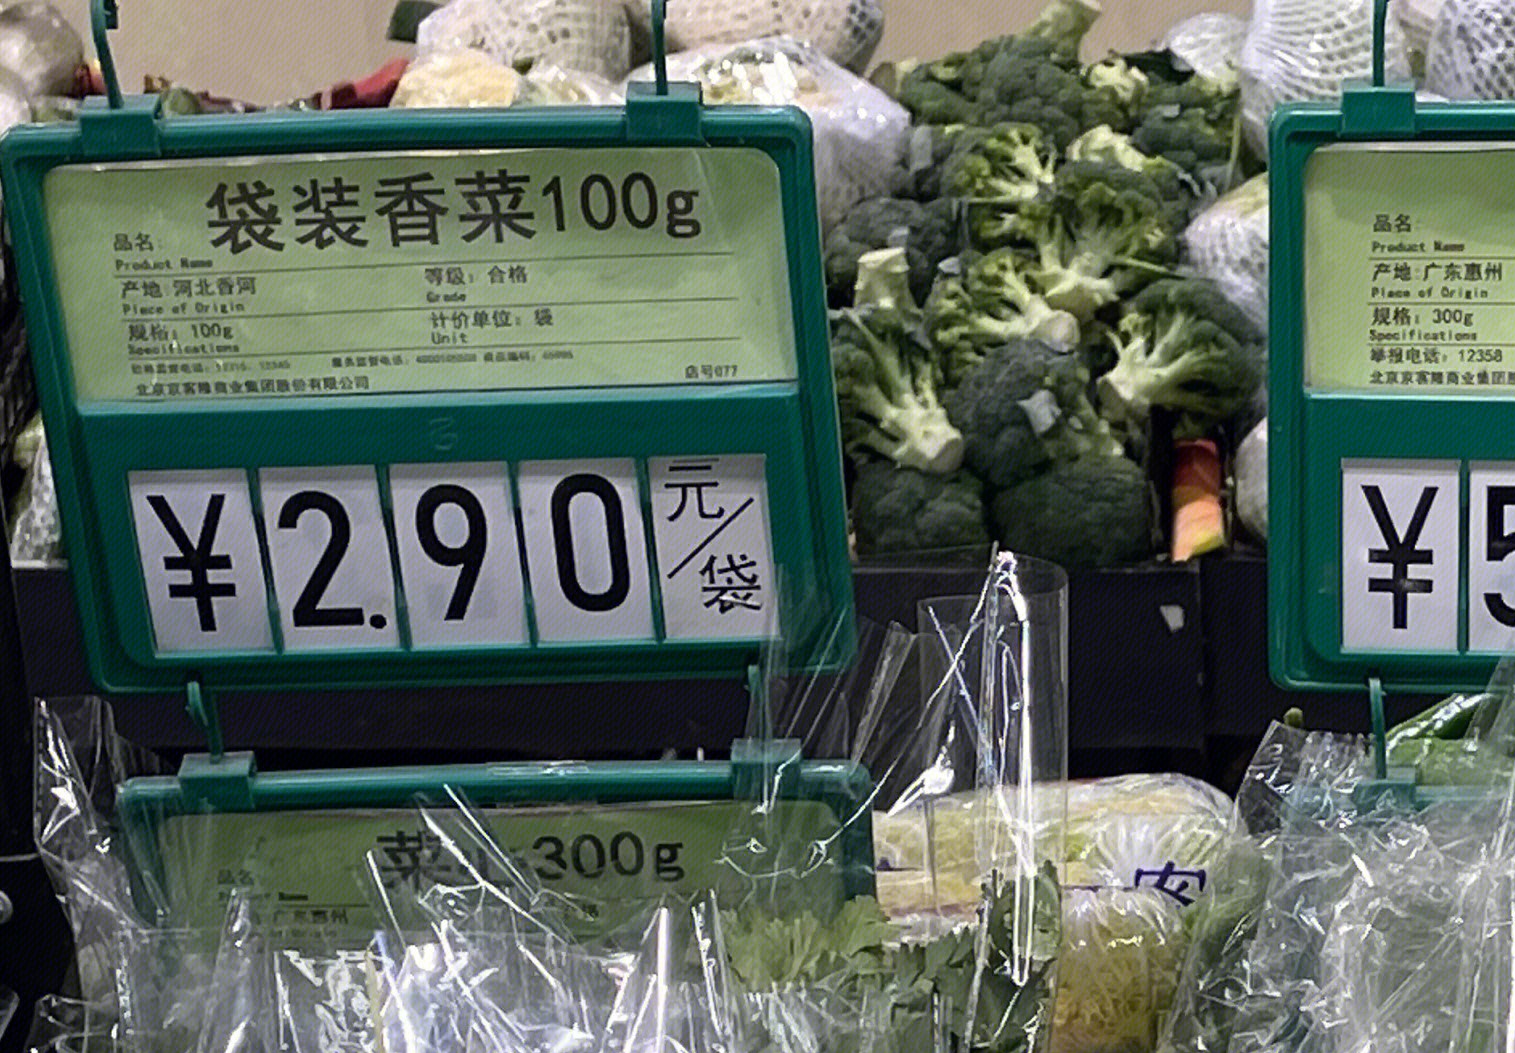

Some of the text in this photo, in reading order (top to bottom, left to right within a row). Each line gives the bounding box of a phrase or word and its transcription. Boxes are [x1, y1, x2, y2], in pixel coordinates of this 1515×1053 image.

[206, 168, 701, 254] 袋装香菜100g
[431, 332, 468, 346] Unit
